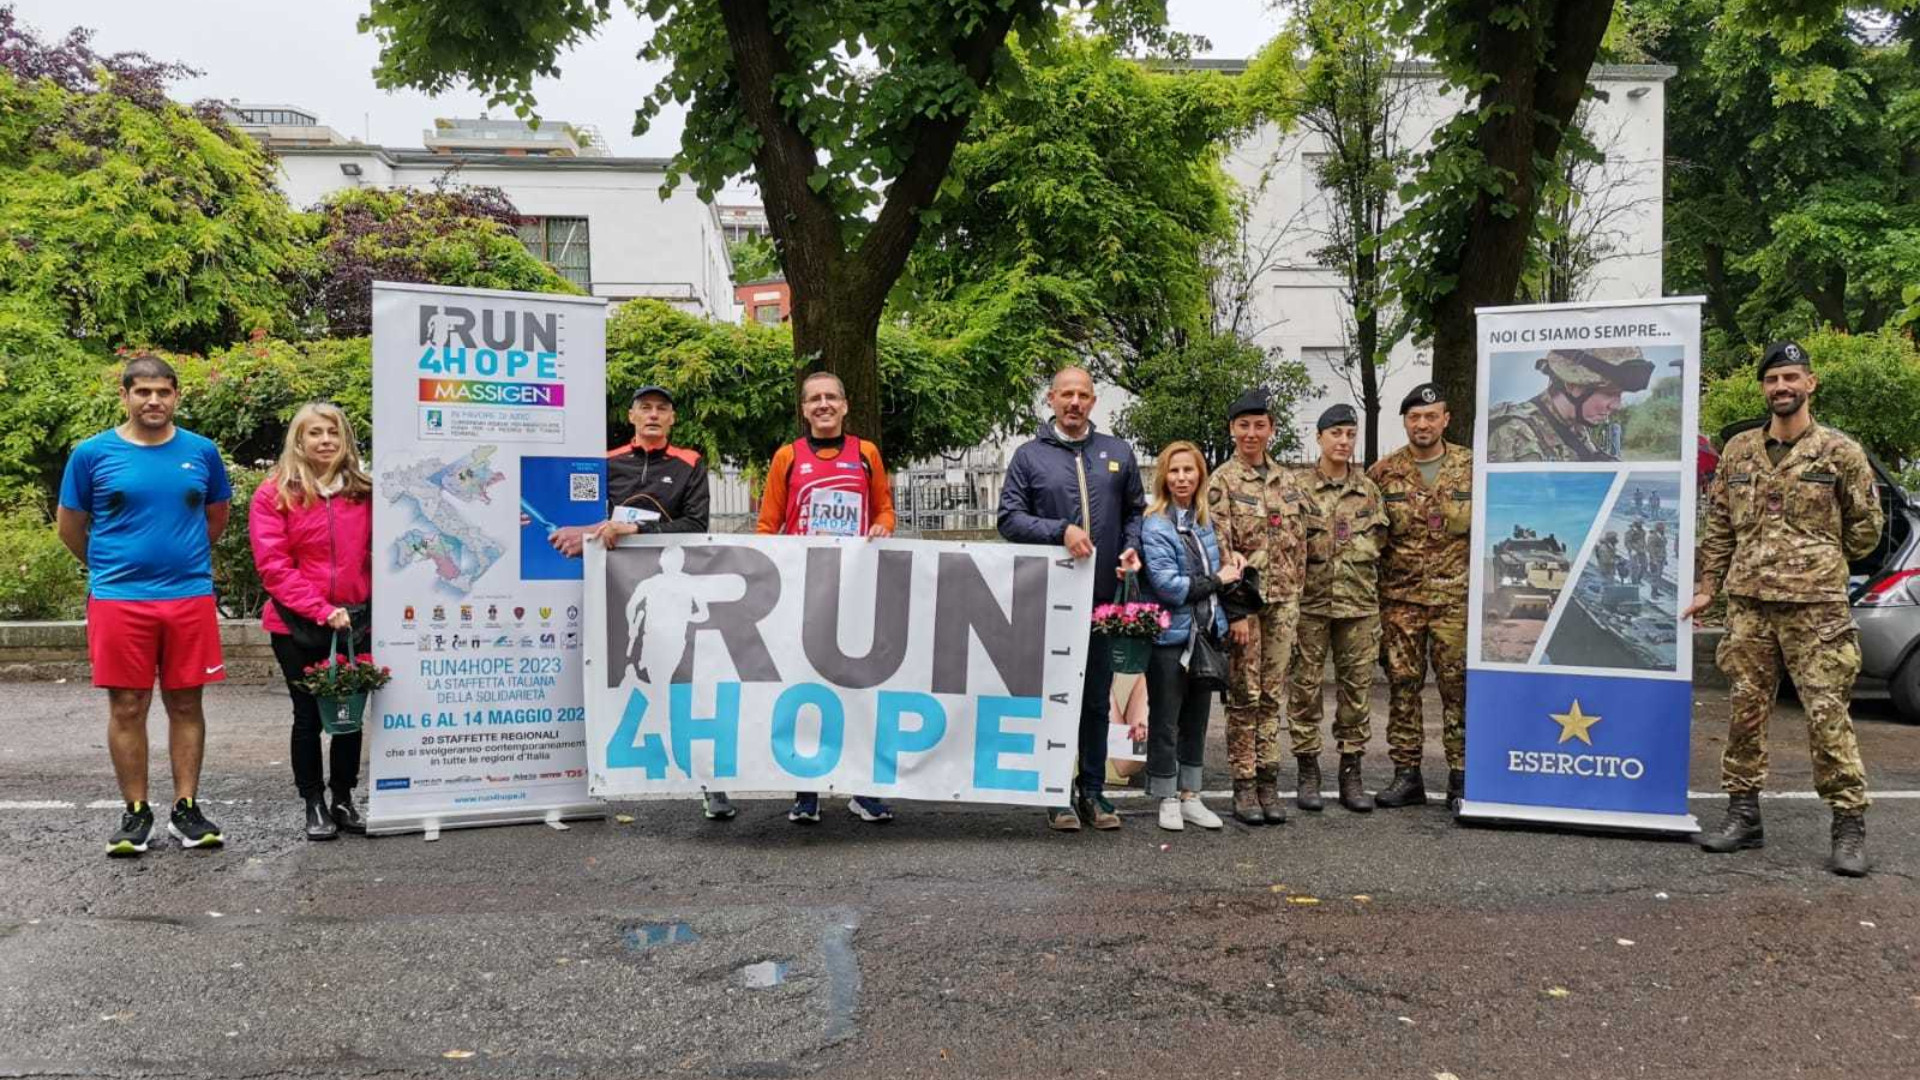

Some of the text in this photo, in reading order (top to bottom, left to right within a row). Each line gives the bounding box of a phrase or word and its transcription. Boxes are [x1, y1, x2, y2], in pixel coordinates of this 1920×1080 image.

[419, 305, 557, 353] RUN
[1489, 324, 1671, 343] NOI CI SIAMO SEMPRE...
[419, 346, 557, 379] 4HOPE
[434, 383, 552, 403] MASSIGEN
[812, 503, 858, 522] RUN
[811, 518, 857, 531] 4HOPE
[605, 545, 1049, 698] RUN
[420, 657, 562, 677] RUN4HOPE 2023
[1045, 557, 1075, 793] ITALIA
[426, 675, 556, 690] LA STAFFETTA ITALIANA
[437, 690, 474, 704] DELLA
[383, 706, 585, 730] DAL 6 AL 14 MAGGIO 202
[422, 730, 559, 745] 20 STAFFETTE REGIONALI
[605, 682, 1043, 792] 4HOPE
[385, 740, 586, 759] che si svolgeranno contemporaneament
[430, 752, 551, 766] in tutte le regioni d'Italia
[1508, 751, 1644, 779] ESERCITO
